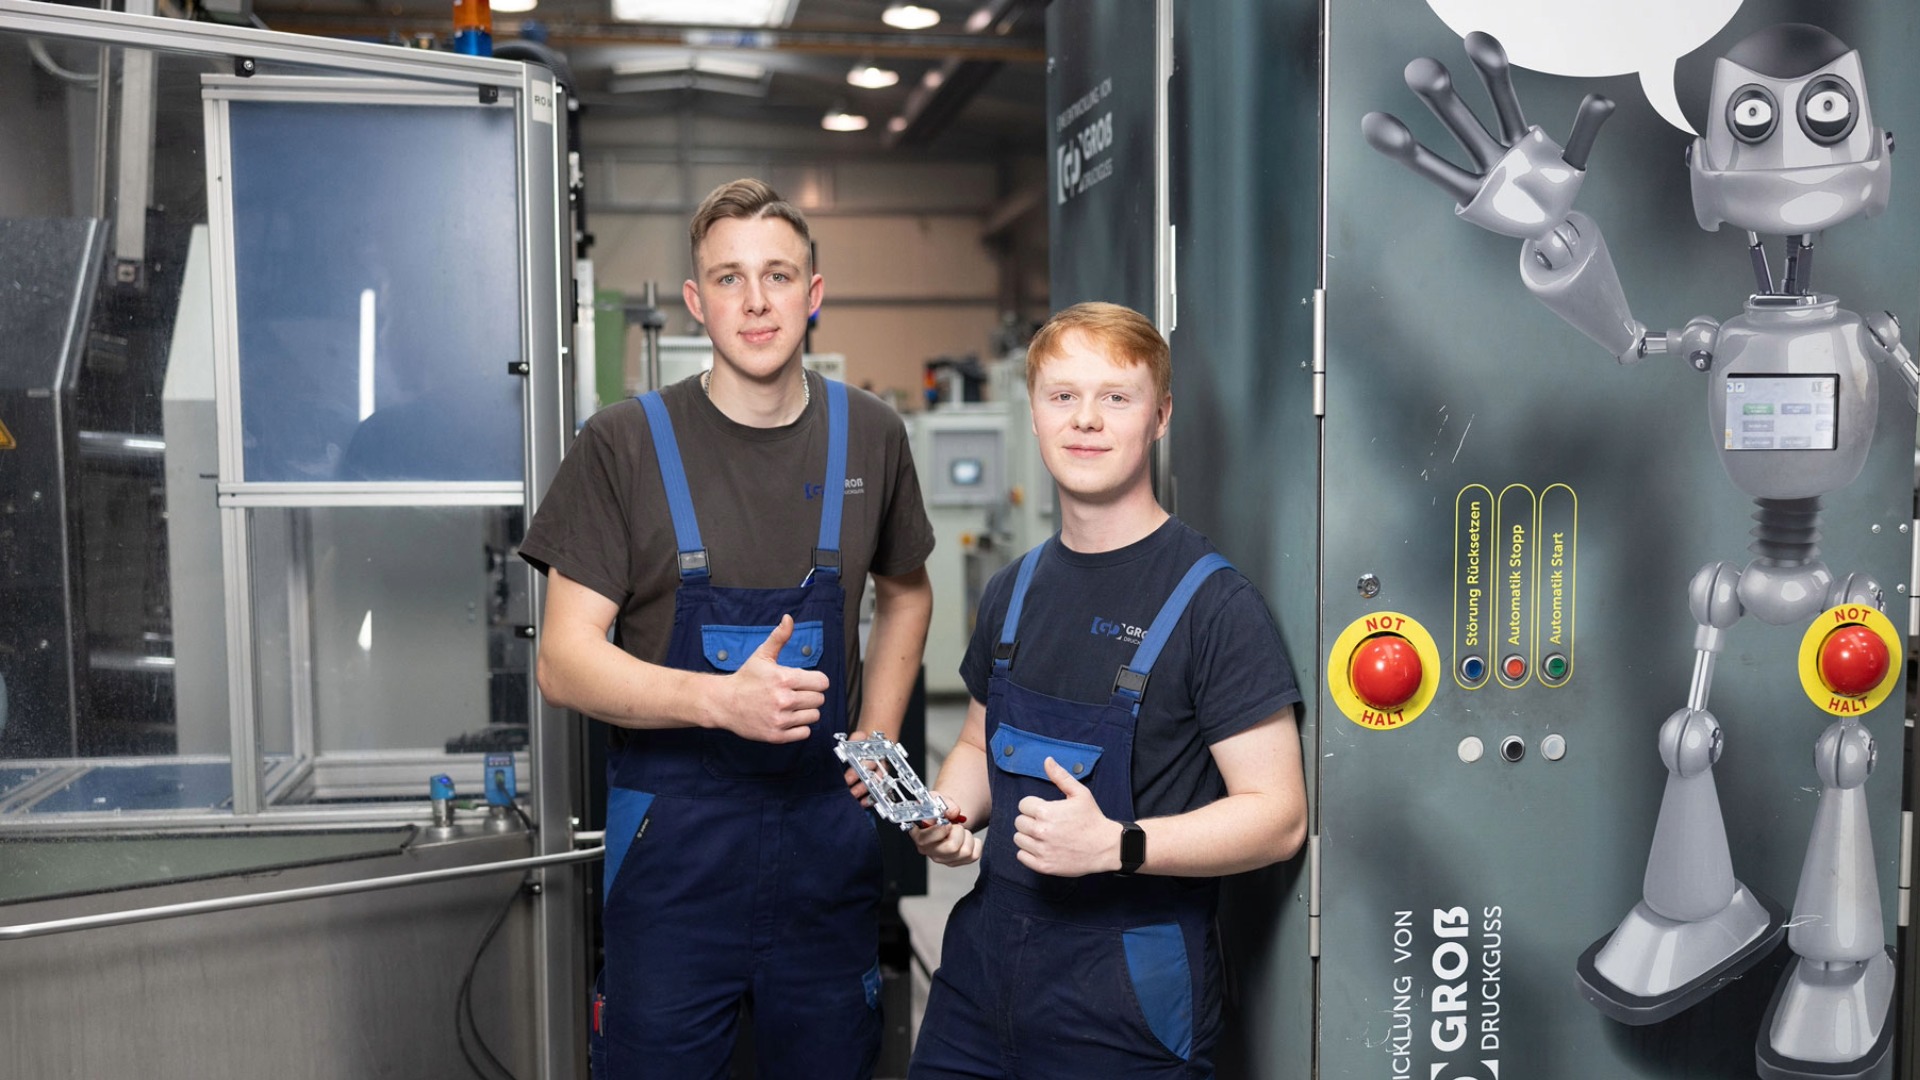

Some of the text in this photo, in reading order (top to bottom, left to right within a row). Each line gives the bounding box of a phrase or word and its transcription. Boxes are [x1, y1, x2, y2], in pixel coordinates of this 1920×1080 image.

[844, 478, 864, 488] ROß
[1466, 501, 1482, 646] Störung Rücksetzen
[1508, 524, 1525, 646] Automatik Stopp
[1549, 532, 1564, 645] Automatik Start
[1365, 616, 1406, 632] NOT
[1834, 608, 1871, 623] NOT
[1123, 635, 1142, 646] DRUCK
[1126, 625, 1149, 640] GRO
[1828, 696, 1868, 713] HALT
[1361, 708, 1405, 726] HALT
[1481, 905, 1502, 1050] DRUCKGUSS
[1393, 911, 1413, 1080] ICKLUNG VON
